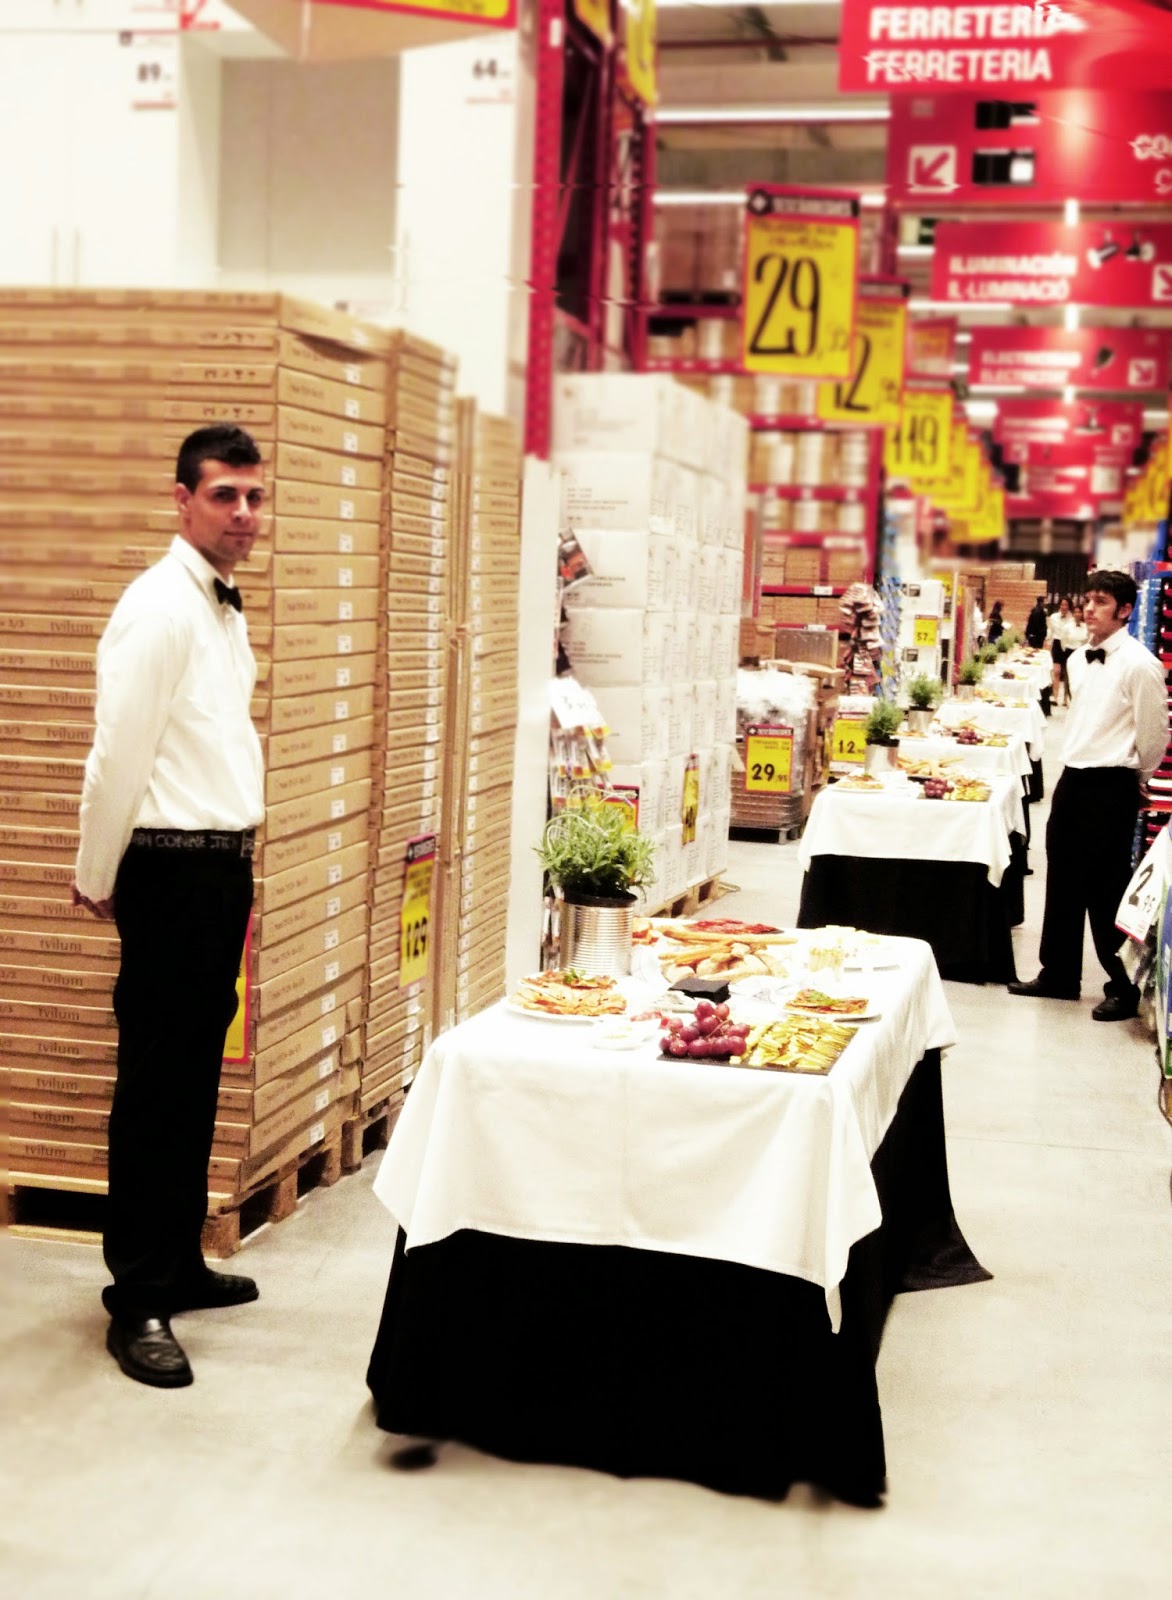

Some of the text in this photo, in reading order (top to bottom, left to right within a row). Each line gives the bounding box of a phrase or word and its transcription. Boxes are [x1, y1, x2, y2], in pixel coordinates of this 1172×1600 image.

[866, 48, 1053, 82] FERRETERIA
[749, 253, 821, 357] 29
[51, 620, 93, 634] tvilum
[51, 656, 92, 670] tvilum
[49, 691, 91, 705] tvilum
[47, 726, 89, 739] tvilum
[751, 763, 775, 782] 29
[1128, 862, 1154, 907] 2
[43, 904, 84, 918] tvilum
[41, 938, 82, 952] tvilum
[42, 973, 82, 986] tvilum
[39, 1007, 79, 1021] tvilum
[39, 1042, 79, 1056] tvilum
[37, 1076, 77, 1090] tvilum
[34, 1111, 74, 1124] tvilum
[26, 1144, 66, 1158] tvilum
